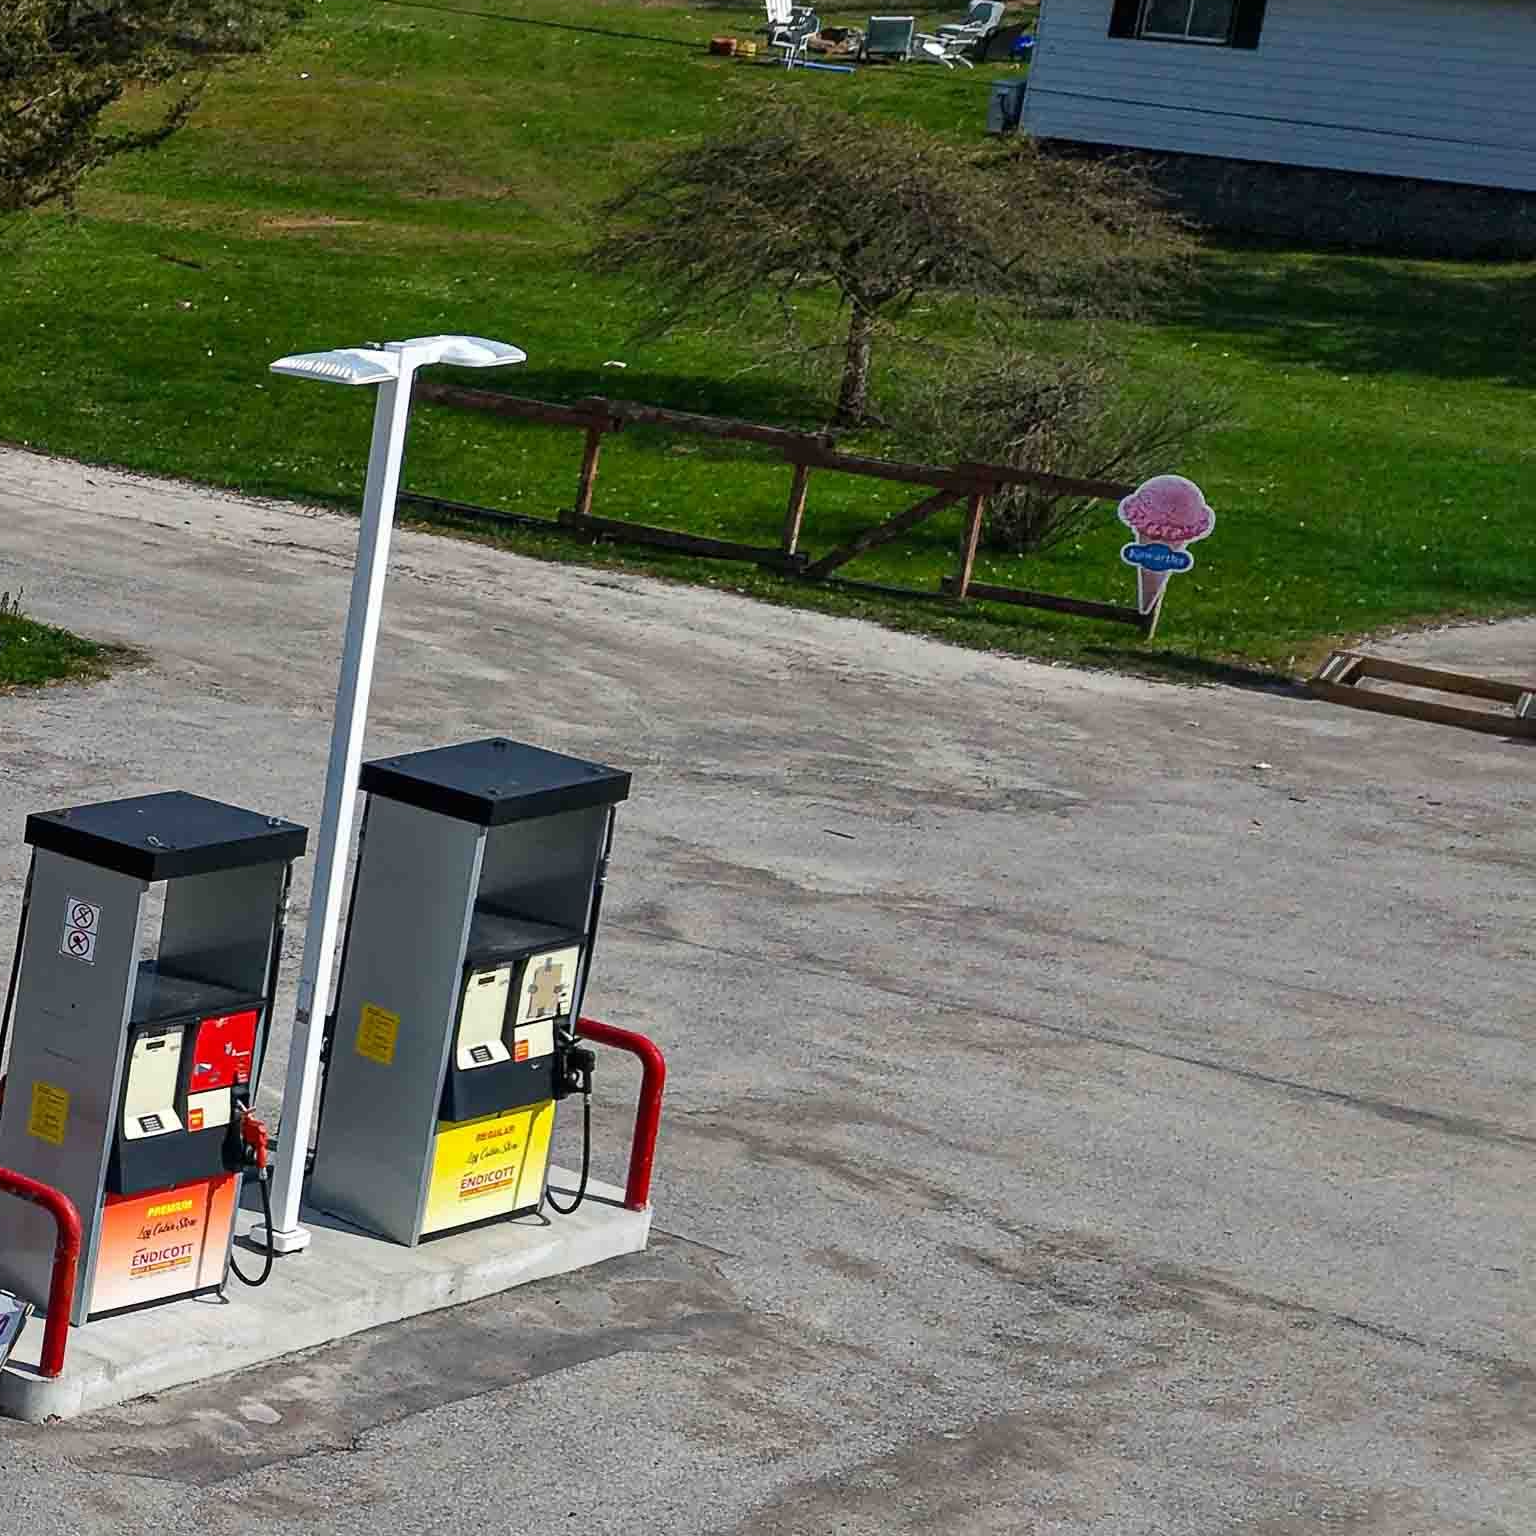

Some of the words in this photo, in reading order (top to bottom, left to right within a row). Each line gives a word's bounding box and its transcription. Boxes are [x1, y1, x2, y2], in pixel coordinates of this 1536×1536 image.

[460, 1166, 515, 1190] ENDICOTT
[147, 1200, 193, 1218] PREMIUM
[131, 1242, 194, 1267] ENDICOTT
